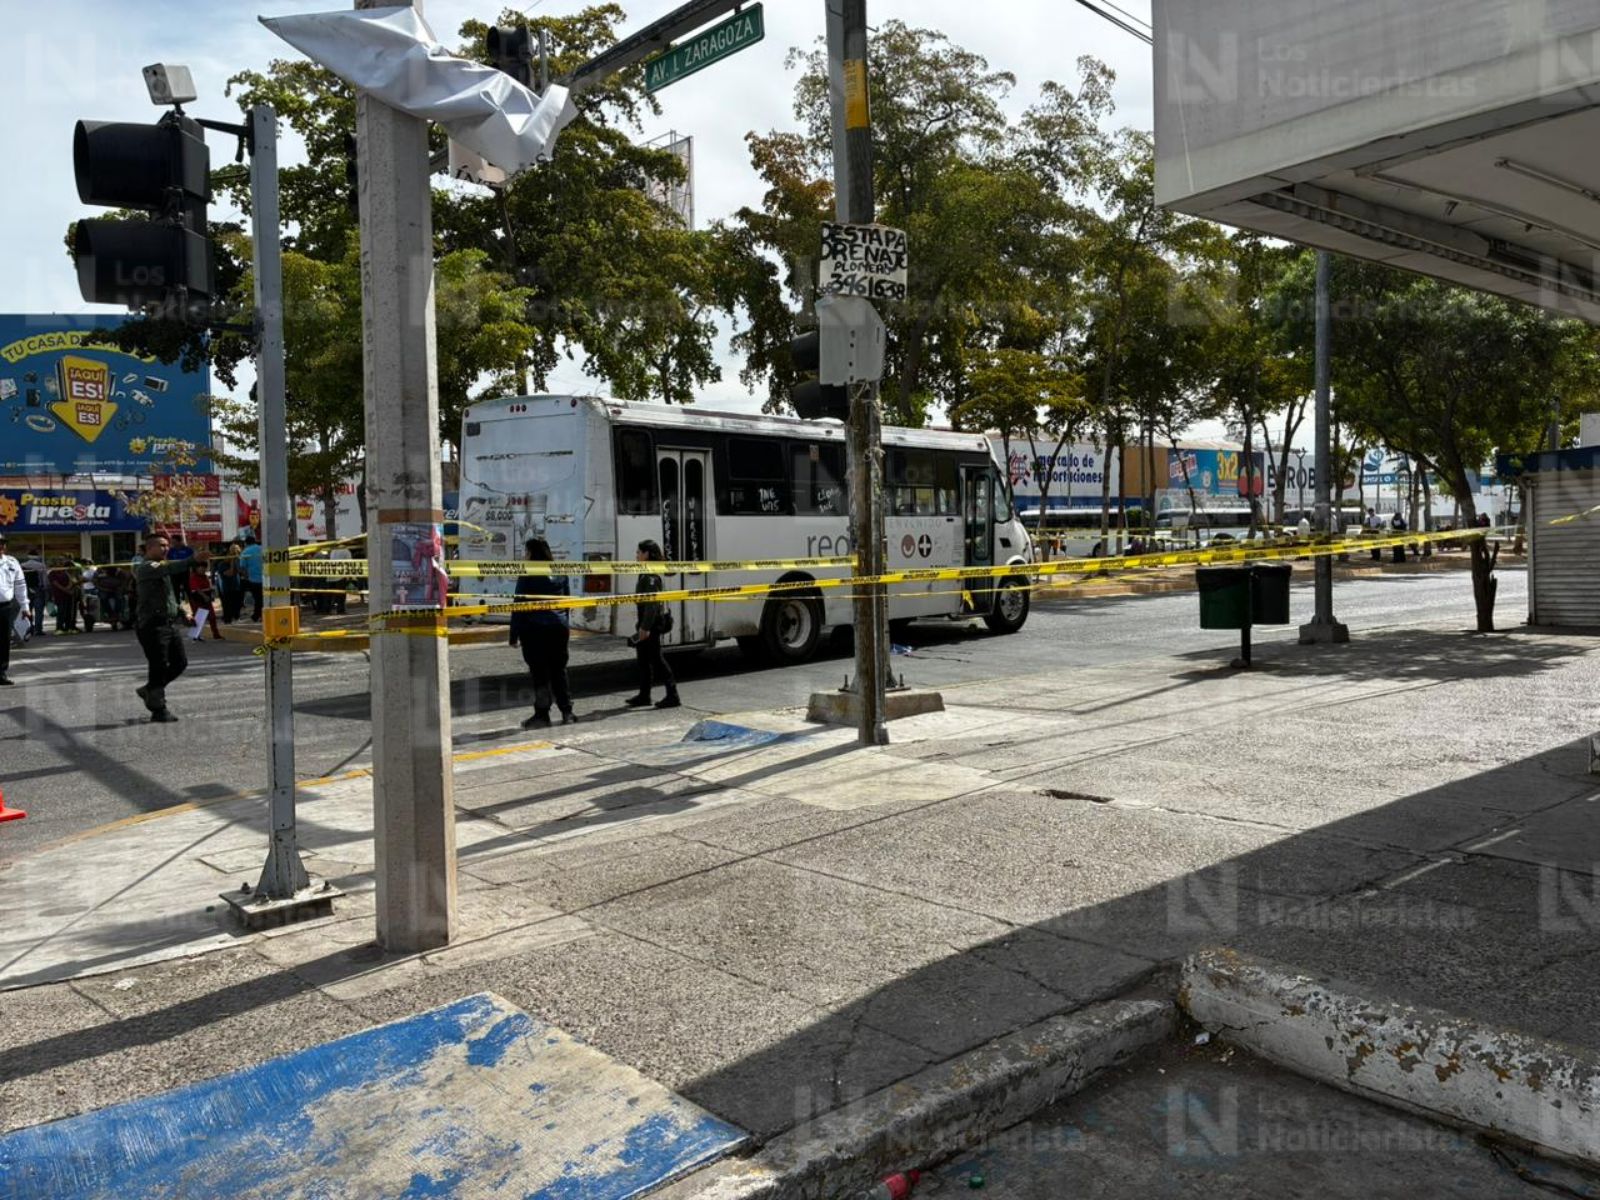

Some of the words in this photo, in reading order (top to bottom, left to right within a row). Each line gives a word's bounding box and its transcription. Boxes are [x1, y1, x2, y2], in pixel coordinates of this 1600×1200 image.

[651, 61, 669, 83] AV.
[684, 16, 754, 68] ZARAGOZA
[821, 223, 908, 255] DESTAPA
[820, 241, 909, 272] DRENAJE
[5, 344, 25, 360] TU
[27, 335, 66, 350] CASA
[71, 382, 104, 399] ES!
[78, 413, 100, 425] ES!
[1082, 454, 1095, 468] de
[20, 493, 77, 507] Presta
[29, 502, 111, 525] presta
[299, 561, 364, 577] PRECAUCION
